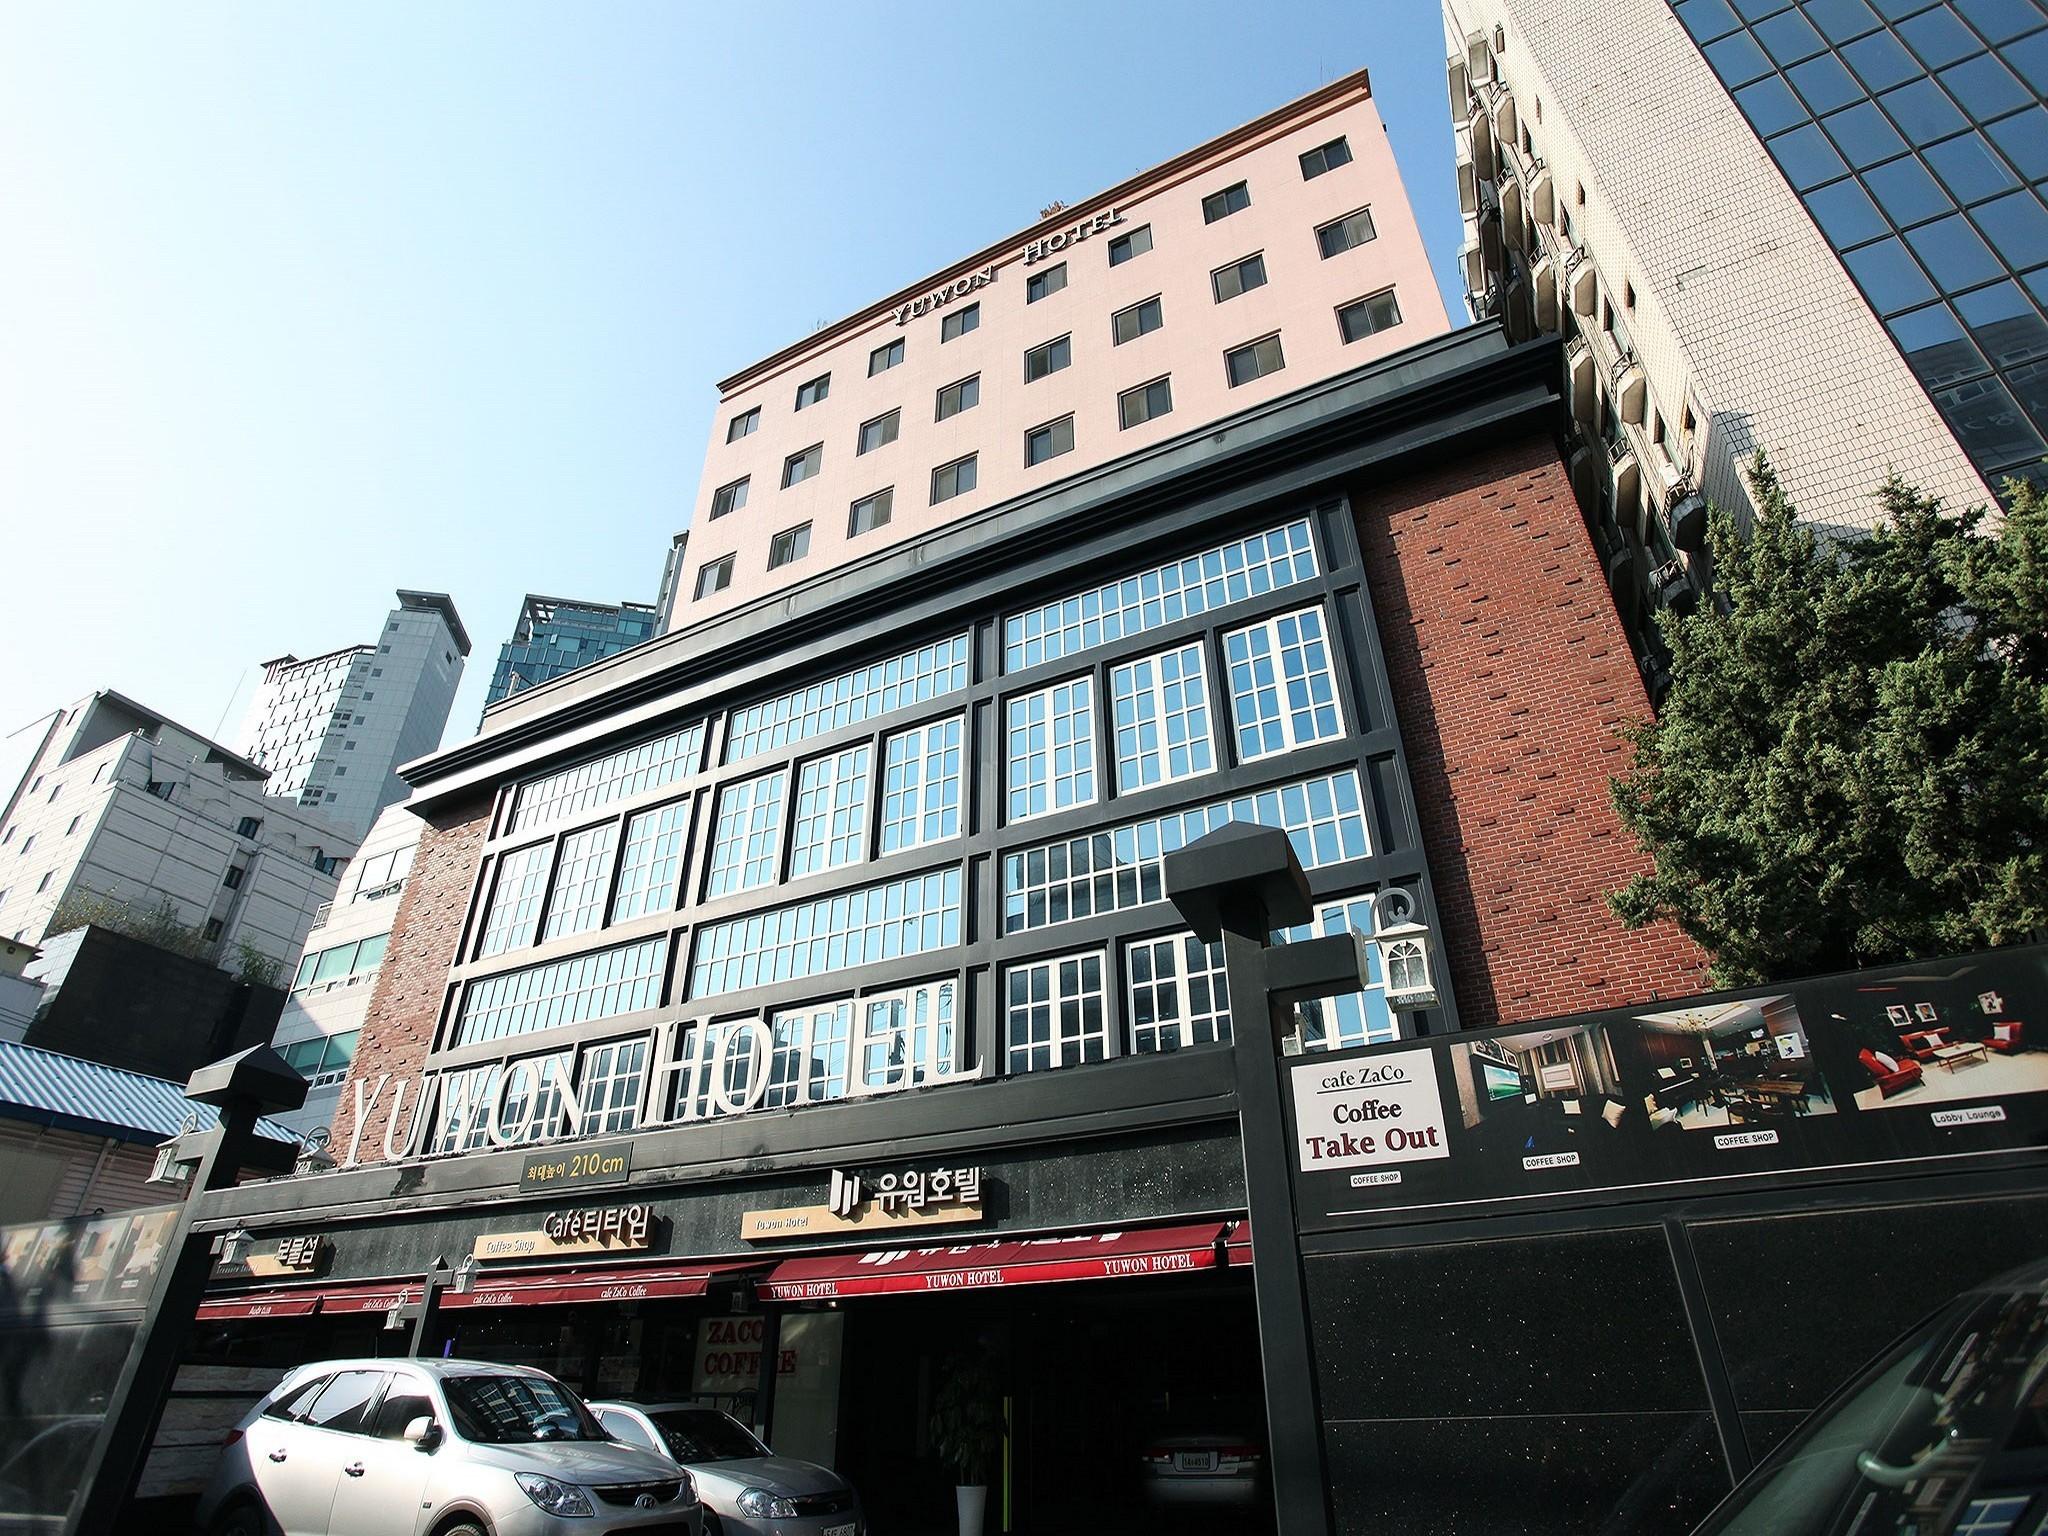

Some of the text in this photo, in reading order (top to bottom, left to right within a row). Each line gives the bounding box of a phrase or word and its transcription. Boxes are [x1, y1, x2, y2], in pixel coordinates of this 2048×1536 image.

[892, 207, 1125, 326] YUWON HOTEL
[340, 981, 984, 1169] YUWON HOTEL
[1322, 1065, 1405, 1089] cafe ZaCo
[1333, 1100, 1402, 1124] Coffee
[1934, 1110, 2001, 1123] Lobby Lounge
[1306, 1126, 1440, 1160] Take Out
[1717, 1133, 1774, 1146] COFFEE SHOP
[569, 1153, 600, 1178] 210
[602, 1157, 623, 1173] cm
[1525, 1154, 1577, 1168] COFFEE SHOP
[874, 1166, 980, 1211] 유원호텔
[1353, 1173, 1399, 1185] COFFEE SHOP
[755, 1216, 809, 1230] Yuwon Hotel
[276, 1235, 319, 1265] 보물섬
[486, 1239, 536, 1254] Coffee Shop
[1103, 1254, 1195, 1275] YUWON HOTEL
[925, 1269, 1004, 1288] YUWON HOTEL
[629, 1285, 647, 1297] Coffee
[771, 1283, 838, 1299] YUWON HOTEL
[704, 1350, 798, 1376] COFFE
